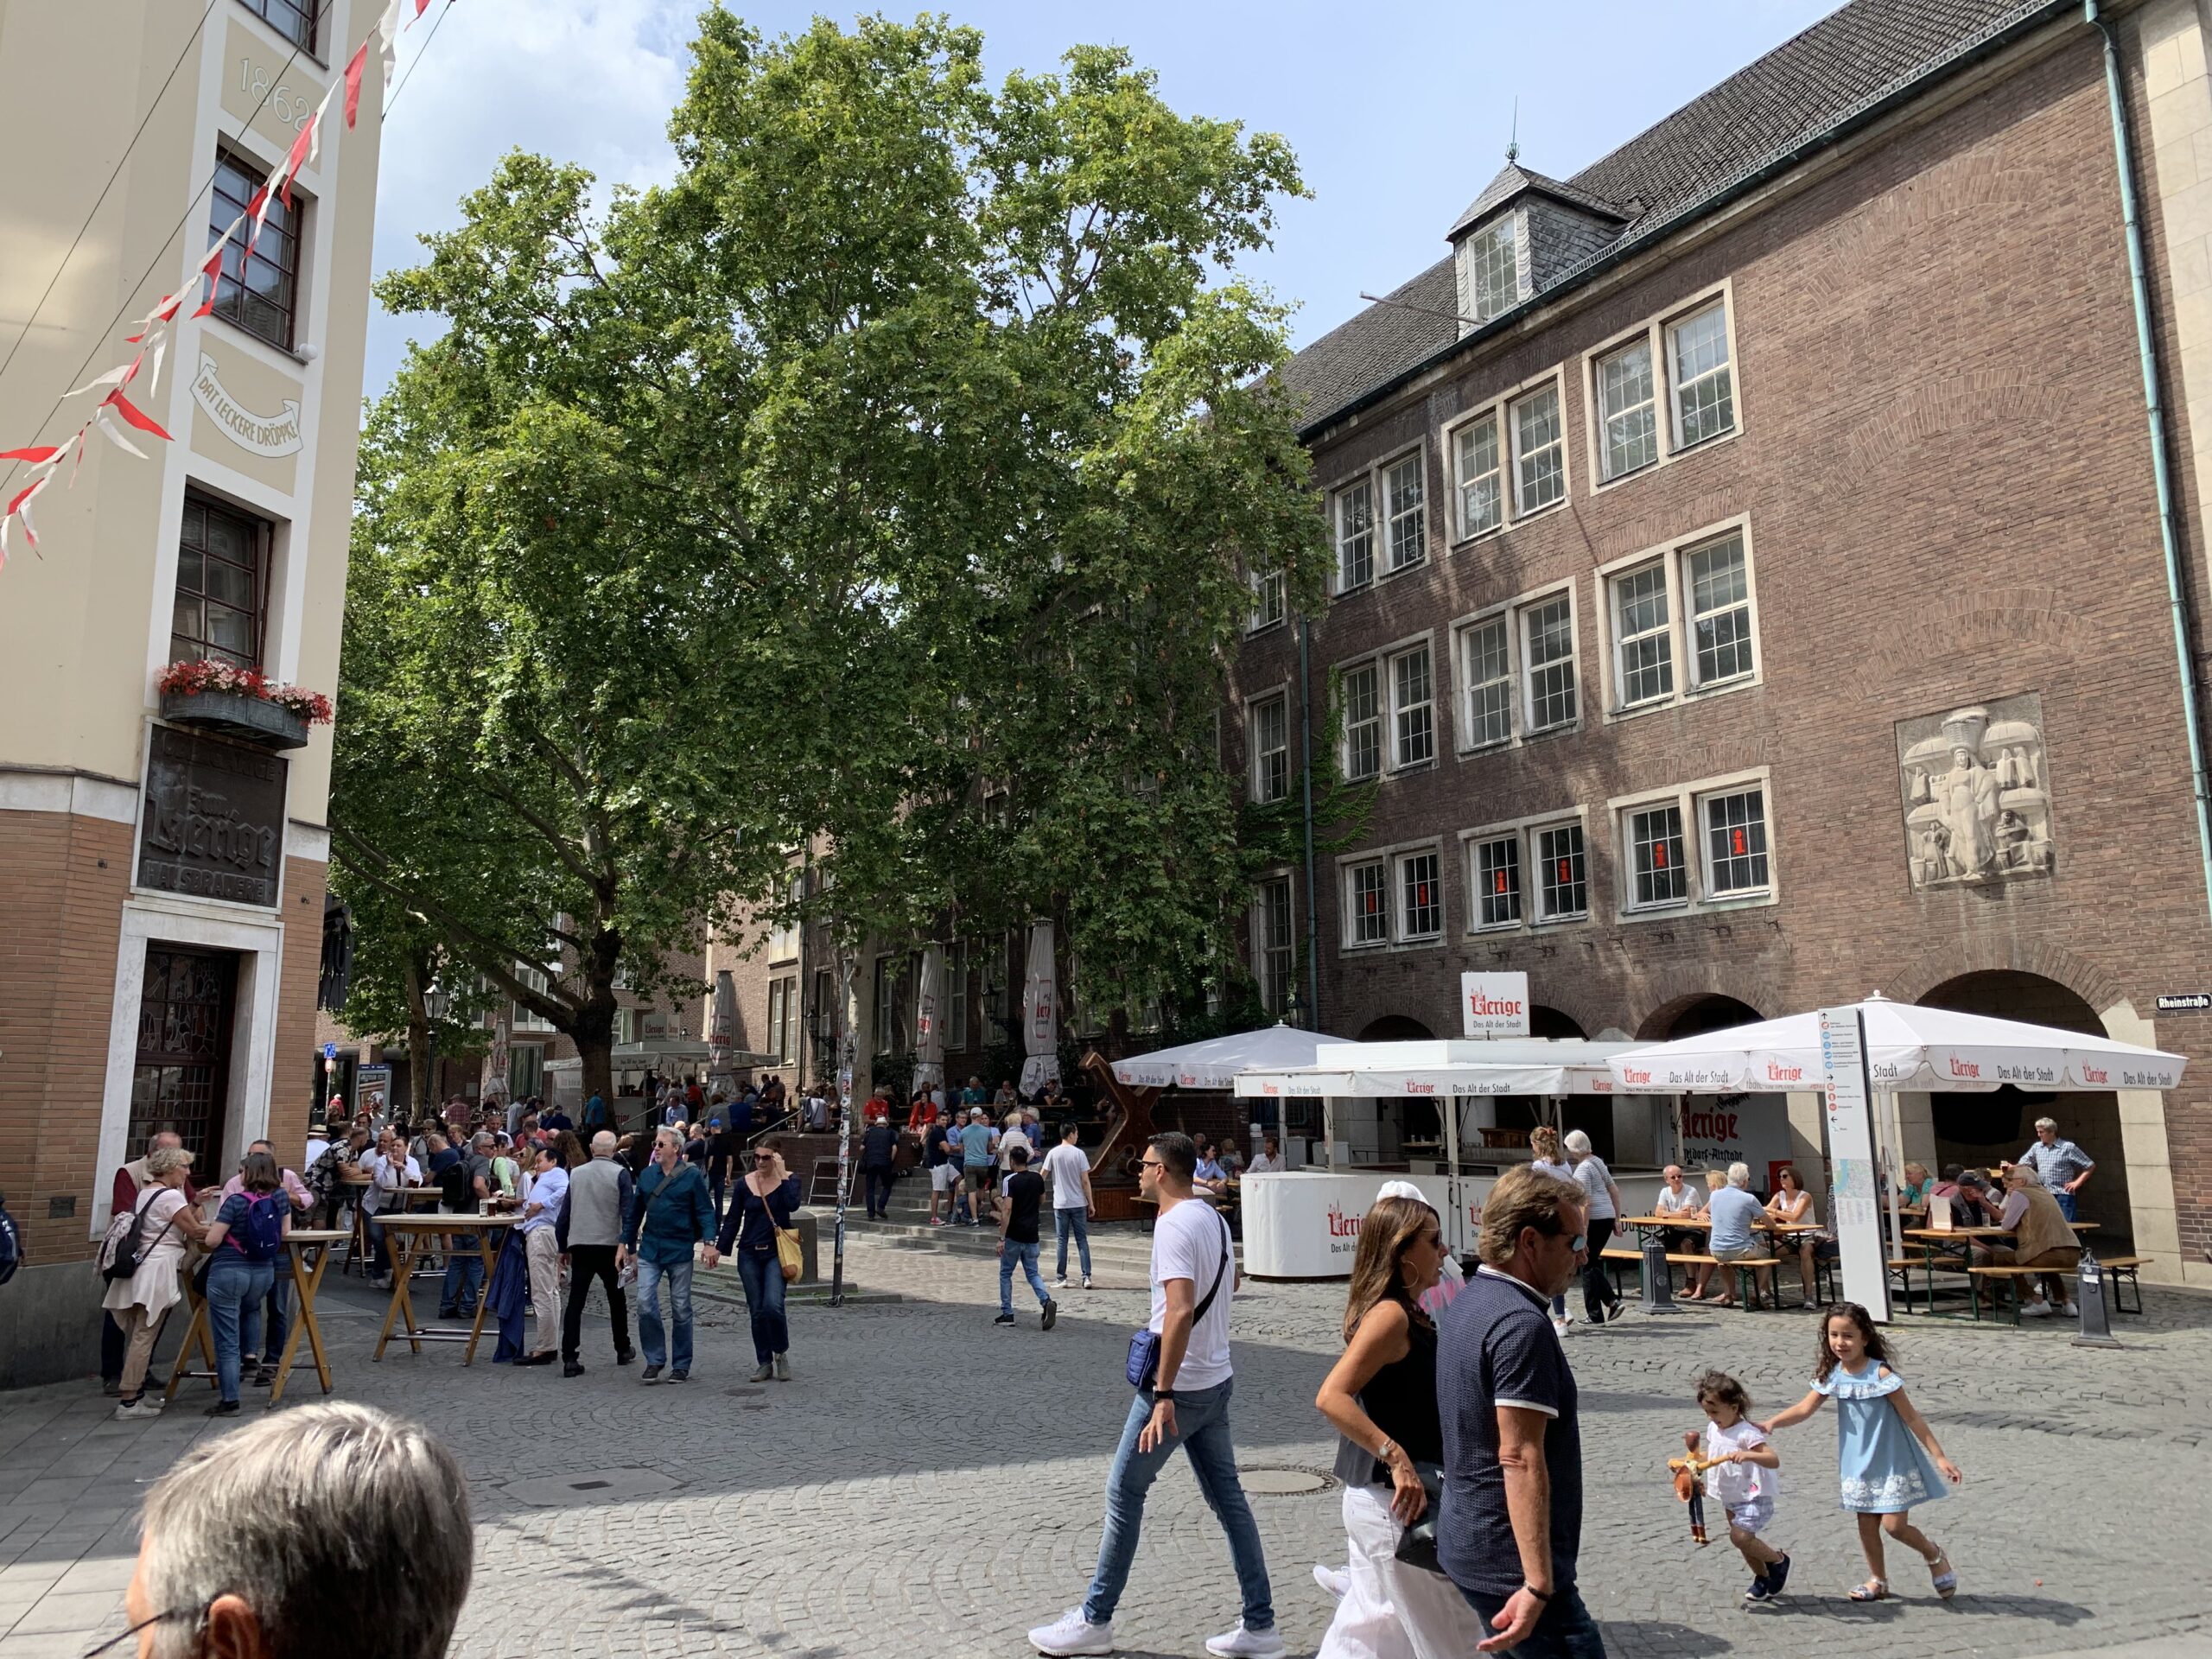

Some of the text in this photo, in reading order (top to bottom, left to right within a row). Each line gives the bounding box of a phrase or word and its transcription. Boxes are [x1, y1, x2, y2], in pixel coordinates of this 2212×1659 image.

[240, 57, 310, 132] 1862
[198, 376, 297, 447] DAT LECKERE DRÖPPKE
[144, 860, 272, 903] HAUSBRAUEREI
[1470, 993, 1521, 1017] Uerige
[2158, 996, 2209, 1008] Rheinstraße
[1624, 1069, 1728, 1084] Uerige Das Alt der Stadt
[1768, 1065, 1802, 1081] Uerige
[1874, 1064, 1898, 1078] Stadt
[1950, 1058, 2053, 1081] Uerige Das Alt der Stadt
[2083, 1065, 2107, 1084] Uerige
[2123, 1071, 2136, 1084] Das
[2147, 1071, 2156, 1085] der
[2158, 1072, 2172, 1086] Stadt
[1407, 1082, 1510, 1094] Uerige Das Alt der Stadt
[1592, 1079, 1612, 1091] Uerige
[1331, 1243, 1342, 1253] Das
